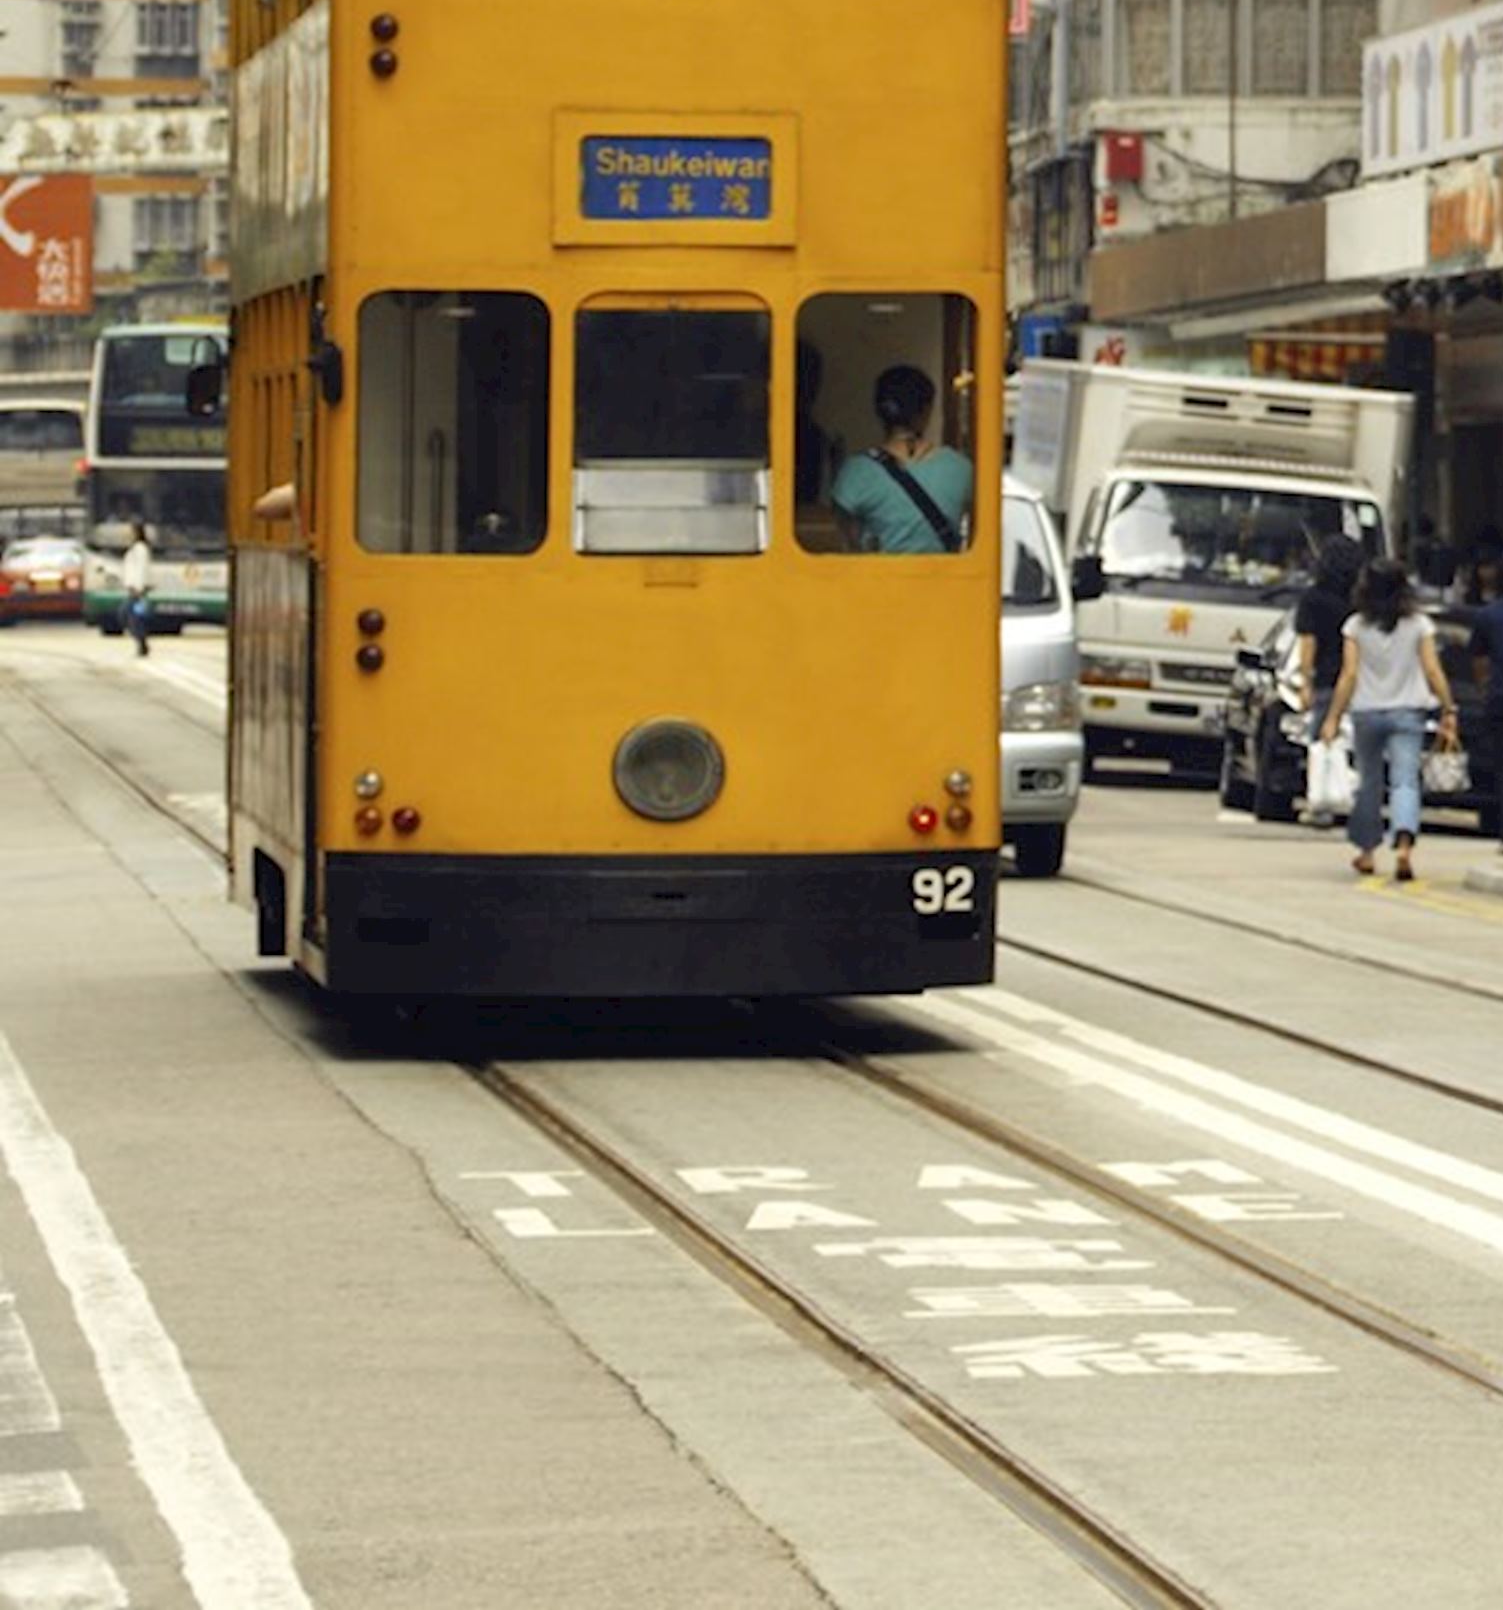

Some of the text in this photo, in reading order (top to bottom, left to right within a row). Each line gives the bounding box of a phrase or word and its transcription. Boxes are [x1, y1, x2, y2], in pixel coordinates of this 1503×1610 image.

[912, 864, 975, 915] 92
[460, 1158, 1266, 1198] TRAM
[493, 1192, 1345, 1239] LANE
